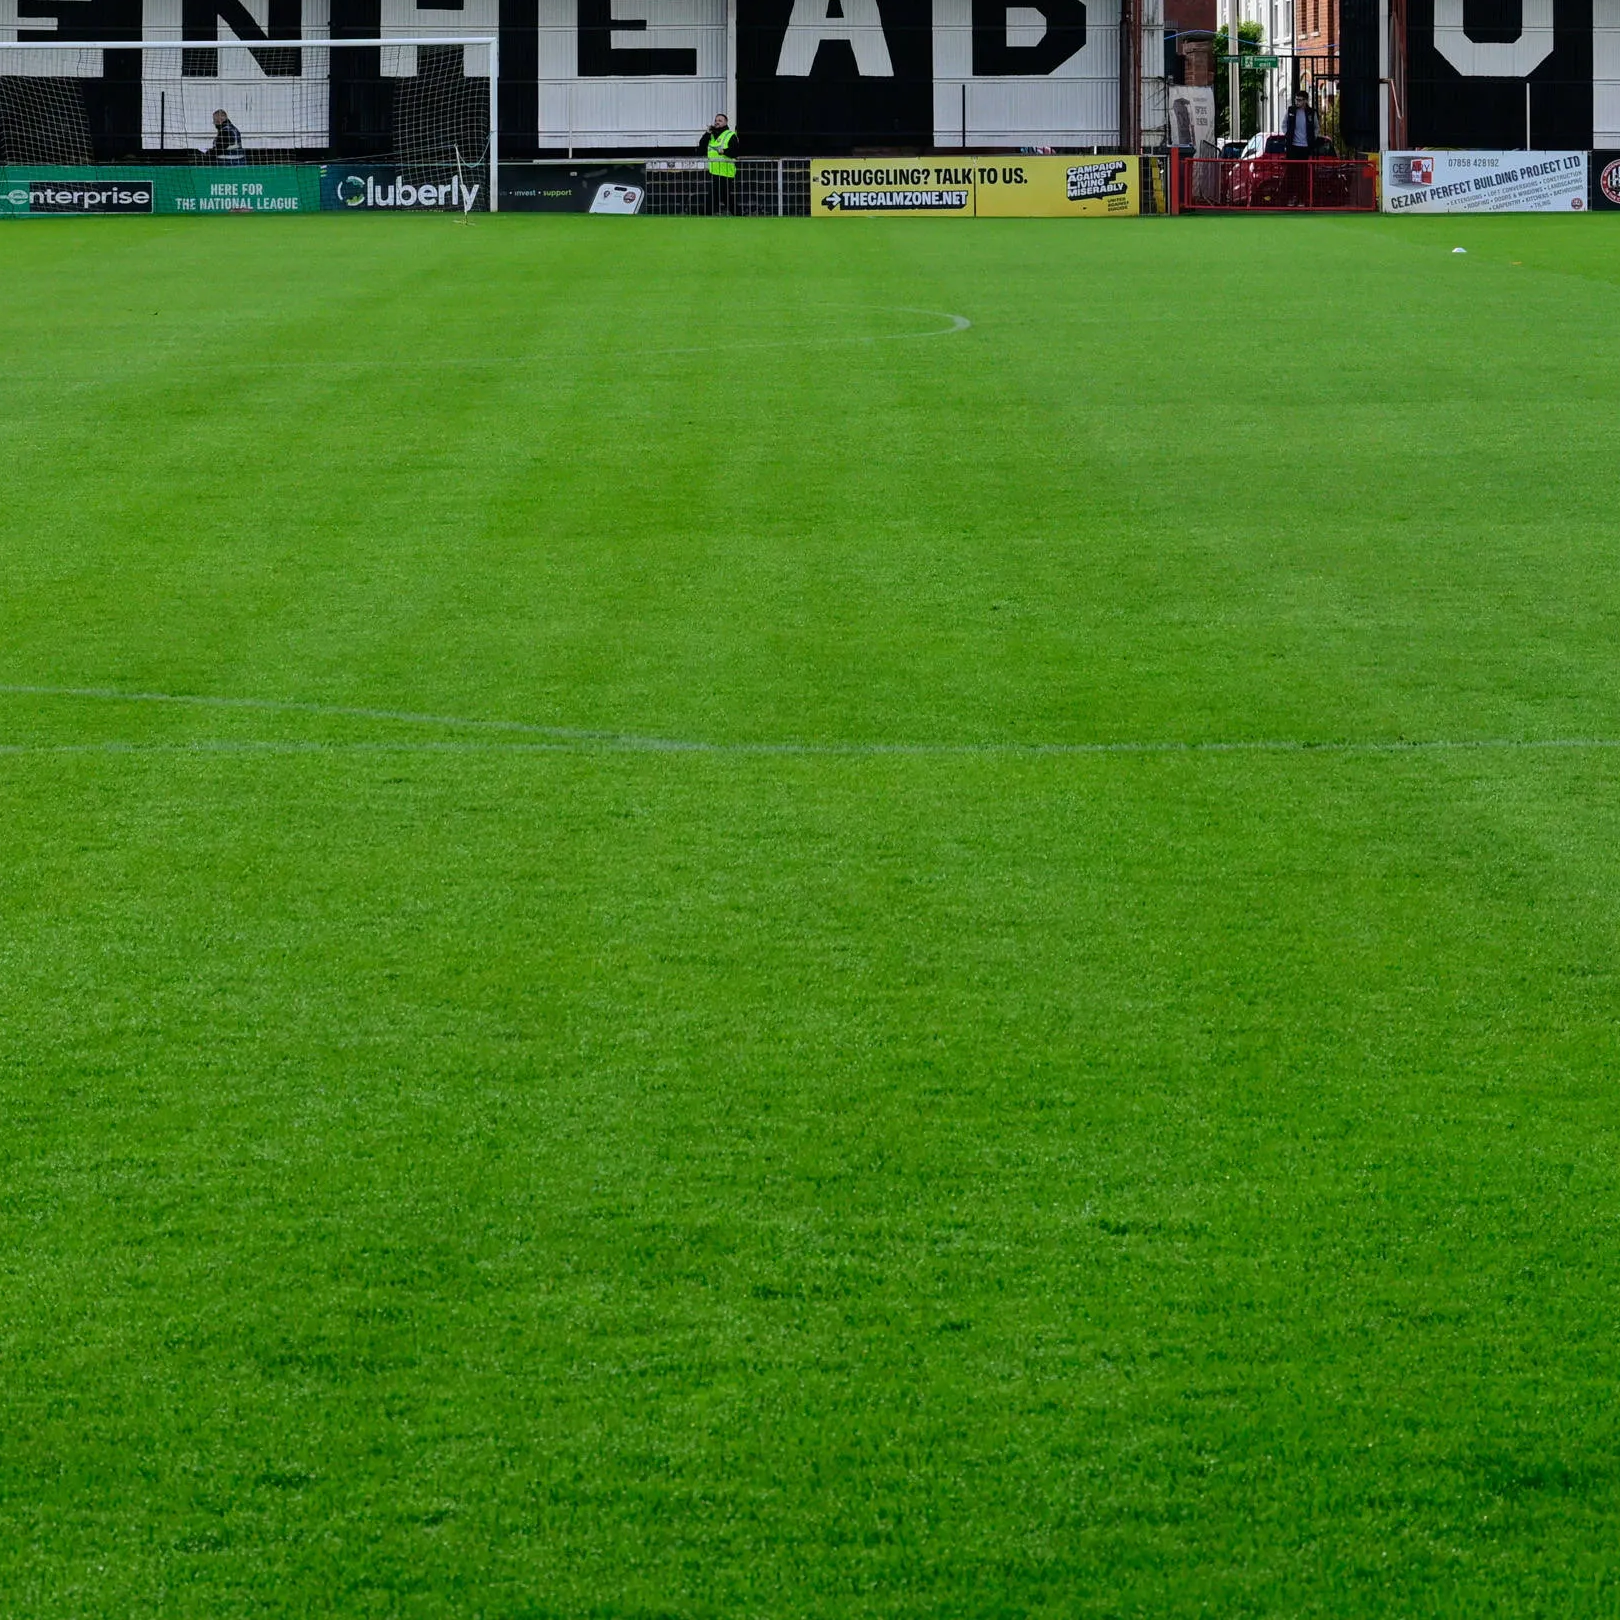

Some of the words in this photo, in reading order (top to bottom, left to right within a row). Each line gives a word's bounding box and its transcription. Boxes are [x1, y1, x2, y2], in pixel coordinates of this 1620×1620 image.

[1067, 161, 1123, 176] CAMPAIGN
[1448, 158, 1471, 167] 07858
[1473, 158, 1499, 168] 428192
[821, 169, 930, 186] STRUGGLING?
[934, 168, 972, 185] TALK
[978, 168, 998, 185] TO
[1003, 167, 1028, 184] US.
[1067, 170, 1112, 182] AGAINST
[1391, 193, 1427, 209] CEZARY
[1430, 180, 1471, 201] PERFECT
[1474, 169, 1518, 191] BUILDING
[1521, 160, 1562, 180] PROJECT
[1564, 155, 1581, 170] LTD
[210, 183, 238, 196] HERE
[242, 183, 263, 195] FOR
[1067, 178, 1104, 190] LIVING
[1067, 183, 1124, 197] MISERABLY
[7, 187, 150, 209] enterprise
[337, 175, 479, 211] Cluberly
[543, 189, 572, 198] support
[842, 191, 968, 207] THECALMZONE.NET
[175, 198, 195, 210] THE
[200, 198, 253, 210] NATIONAL
[257, 198, 298, 210] LEAGUE
